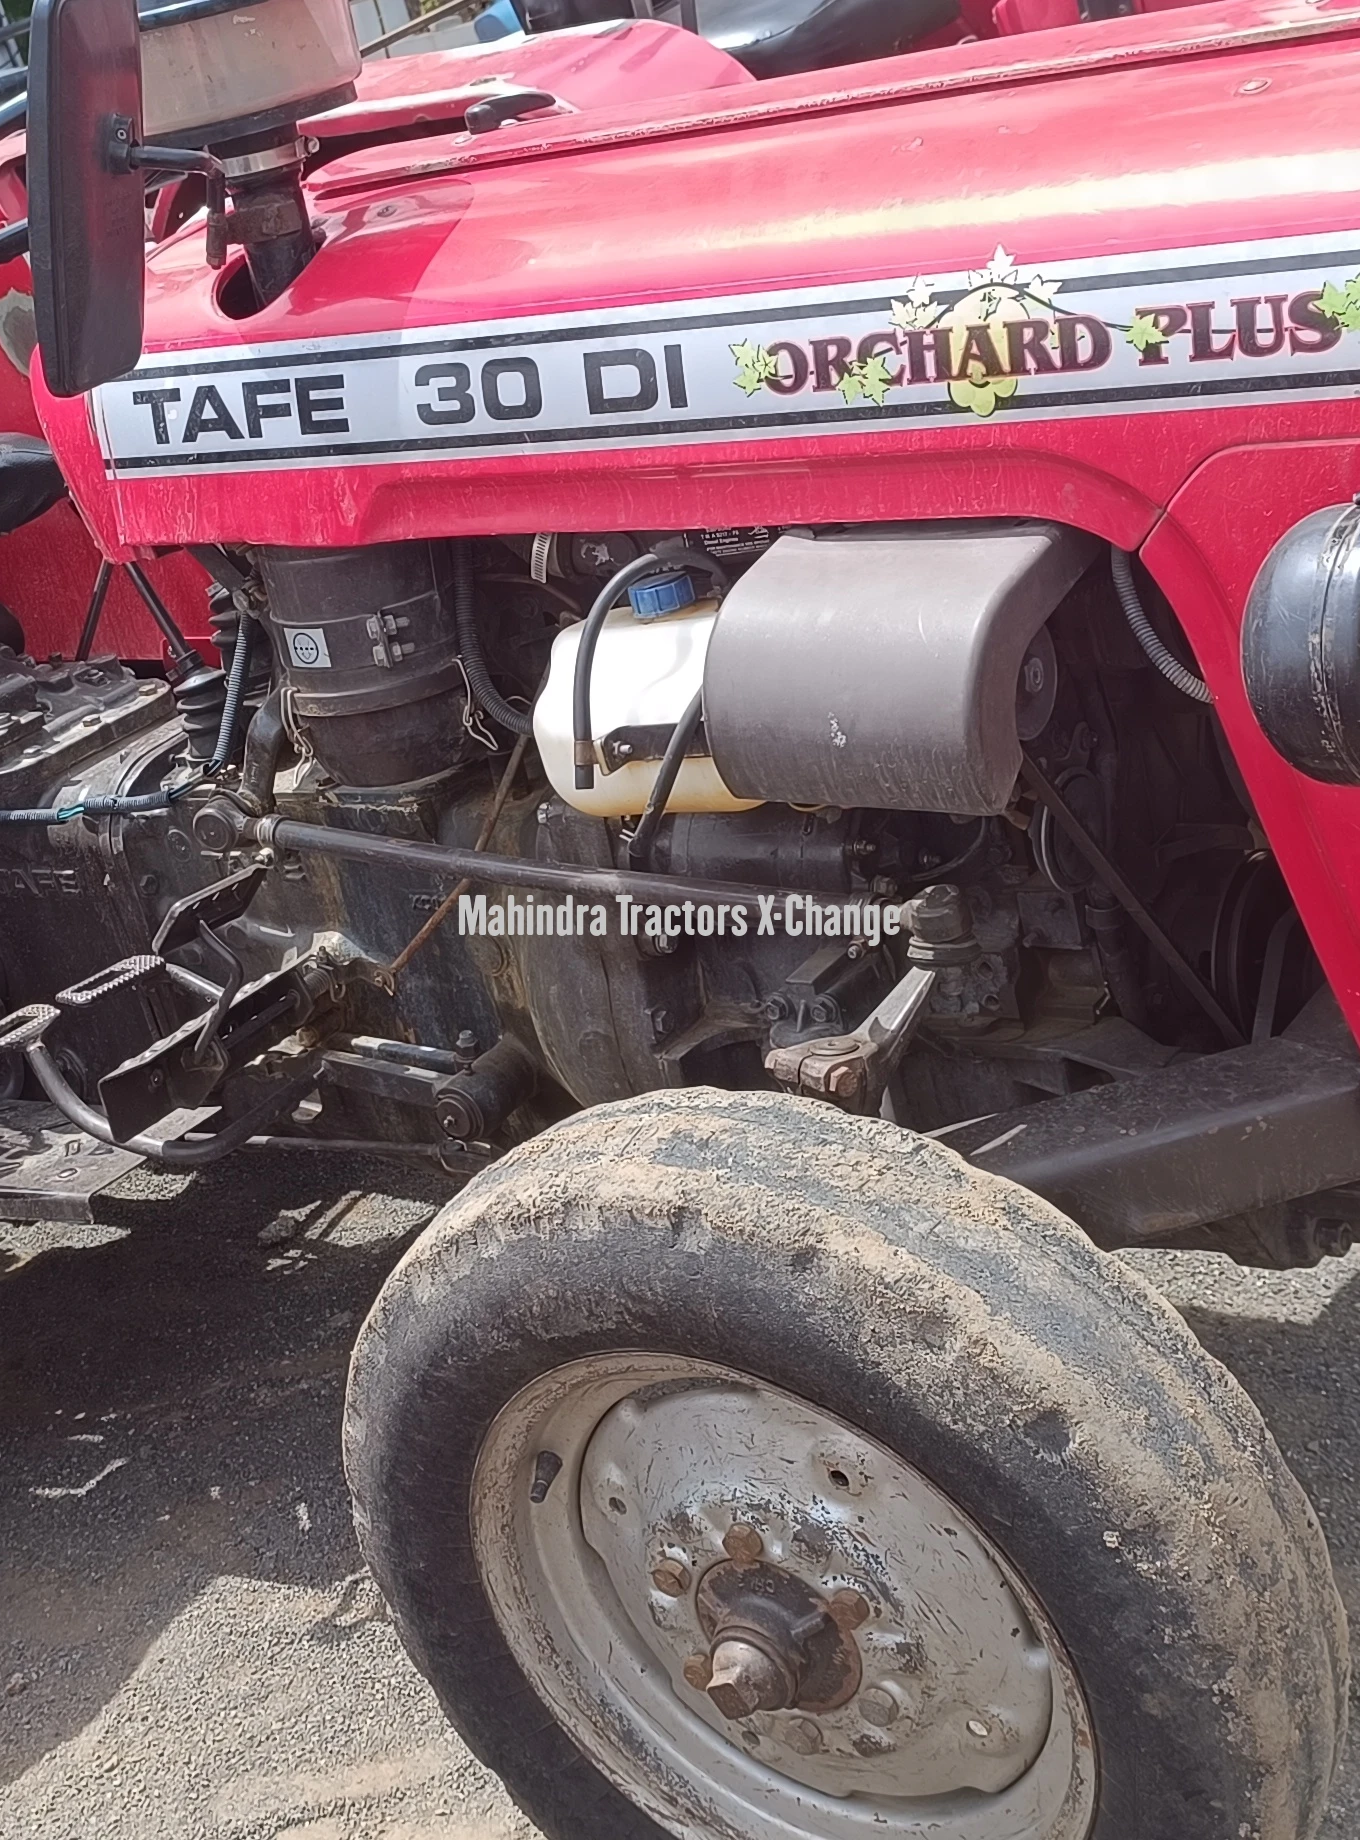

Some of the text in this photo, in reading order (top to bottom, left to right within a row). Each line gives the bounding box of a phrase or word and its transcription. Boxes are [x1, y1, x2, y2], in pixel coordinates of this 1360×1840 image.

[132, 289, 1342, 446] TAFE 30 DI ORCHARD PLUS
